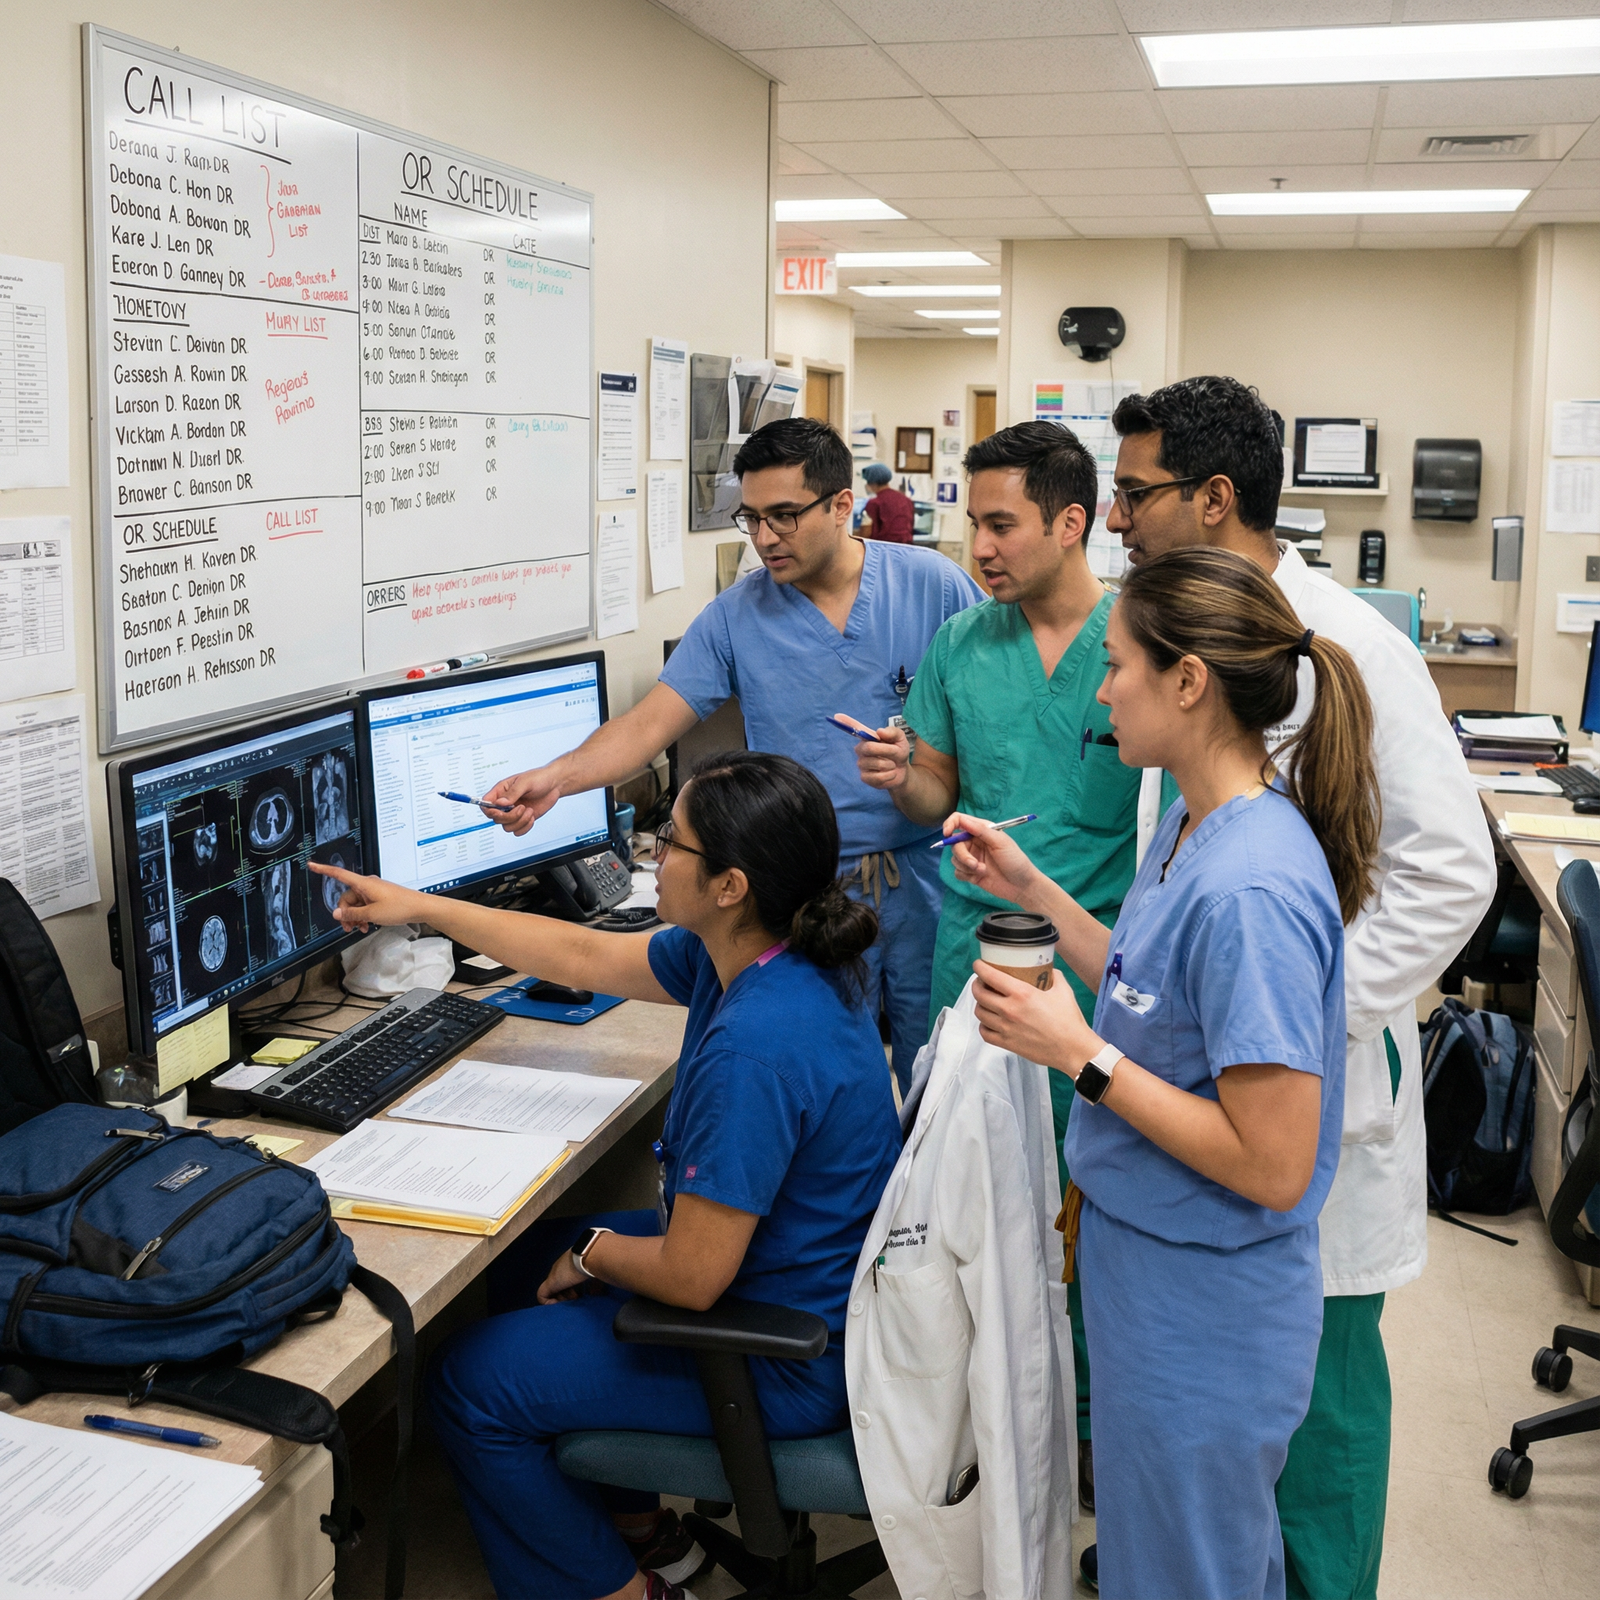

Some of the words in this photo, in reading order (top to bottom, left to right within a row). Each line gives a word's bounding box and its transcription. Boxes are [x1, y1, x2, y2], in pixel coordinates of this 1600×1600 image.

[124, 66, 204, 126] CALL
[221, 95, 287, 149] LIST
[169, 175, 181, 194] C.
[186, 179, 211, 201] Hon
[216, 185, 234, 205] DR
[402, 151, 434, 195] OR
[447, 165, 539, 222] SCHEDULE
[169, 205, 181, 224] A.
[234, 219, 251, 239] DR
[394, 202, 428, 228] NAME
[112, 225, 145, 247] Kare
[150, 231, 161, 249] J.
[168, 234, 190, 253] Len
[196, 238, 214, 257] DR
[180, 263, 223, 291] Ganney
[229, 270, 246, 288] DR
[783, 257, 828, 290] EXIT
[303, 315, 326, 333] LIST
[174, 364, 186, 383] A.
[115, 395, 159, 414] Larson
[165, 394, 177, 412] D.
[170, 423, 182, 440] A.
[230, 420, 247, 437] DR
[173, 480, 185, 498] C.
[236, 472, 254, 491] DR
[152, 516, 217, 542] SCHEDULE
[266, 511, 292, 531] CALL
[295, 508, 319, 525] LIST
[230, 573, 246, 591] DR
[233, 598, 250, 617] DR
[259, 647, 276, 667] DR
